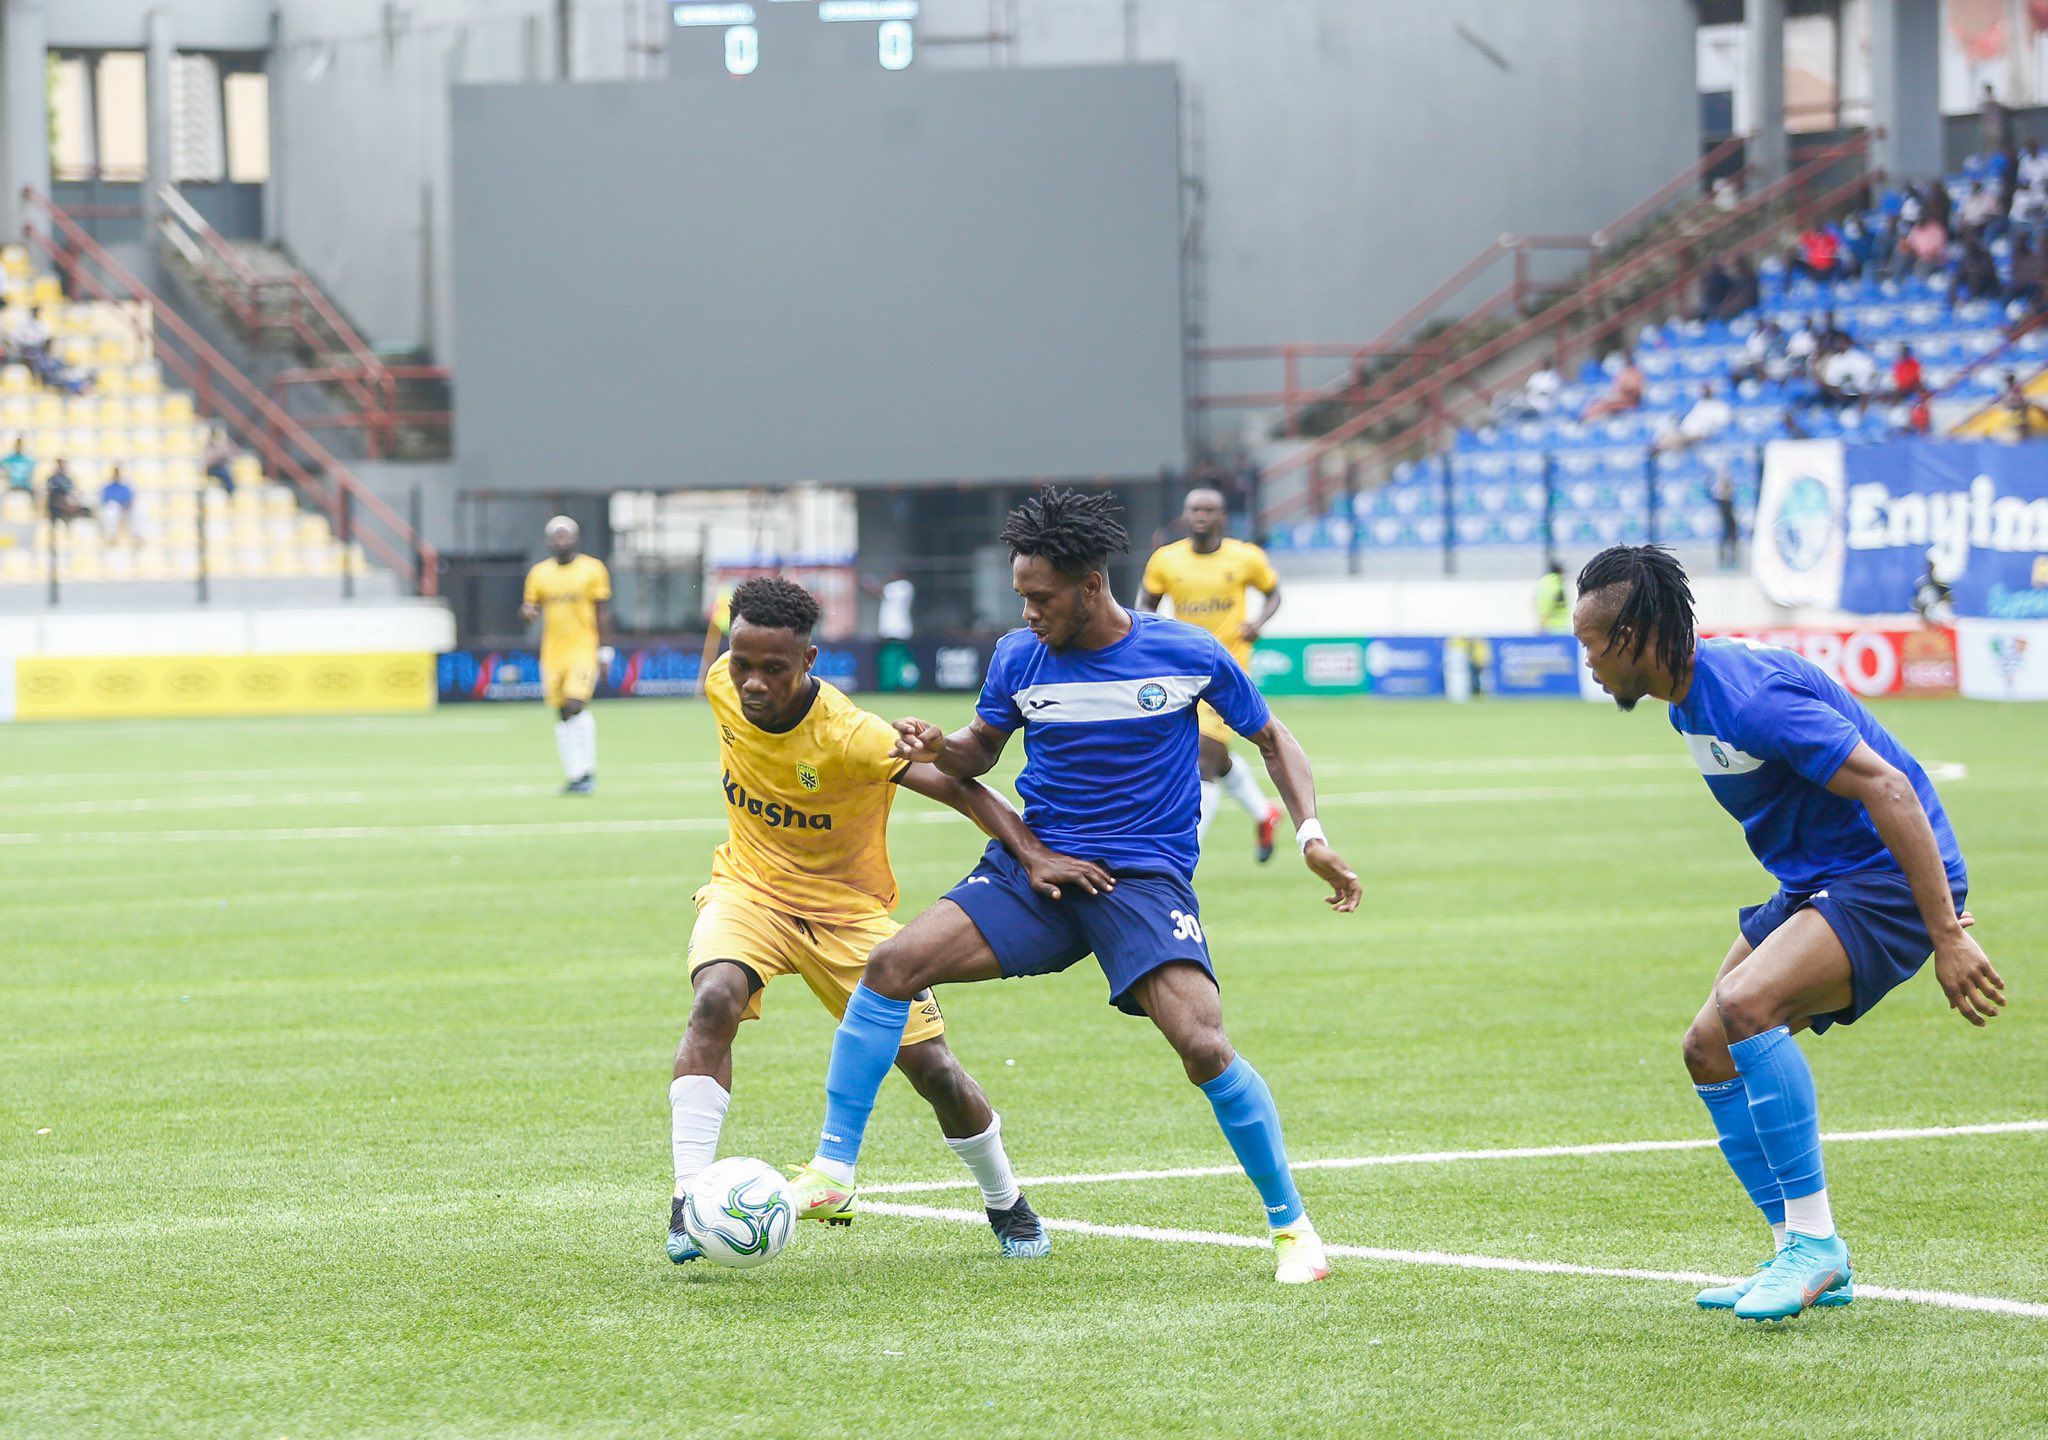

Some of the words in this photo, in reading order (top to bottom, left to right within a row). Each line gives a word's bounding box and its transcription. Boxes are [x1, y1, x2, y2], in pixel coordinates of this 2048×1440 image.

[725, 25, 758, 74] 0
[879, 20, 912, 69] 0
[1170, 909, 1203, 943] 30
